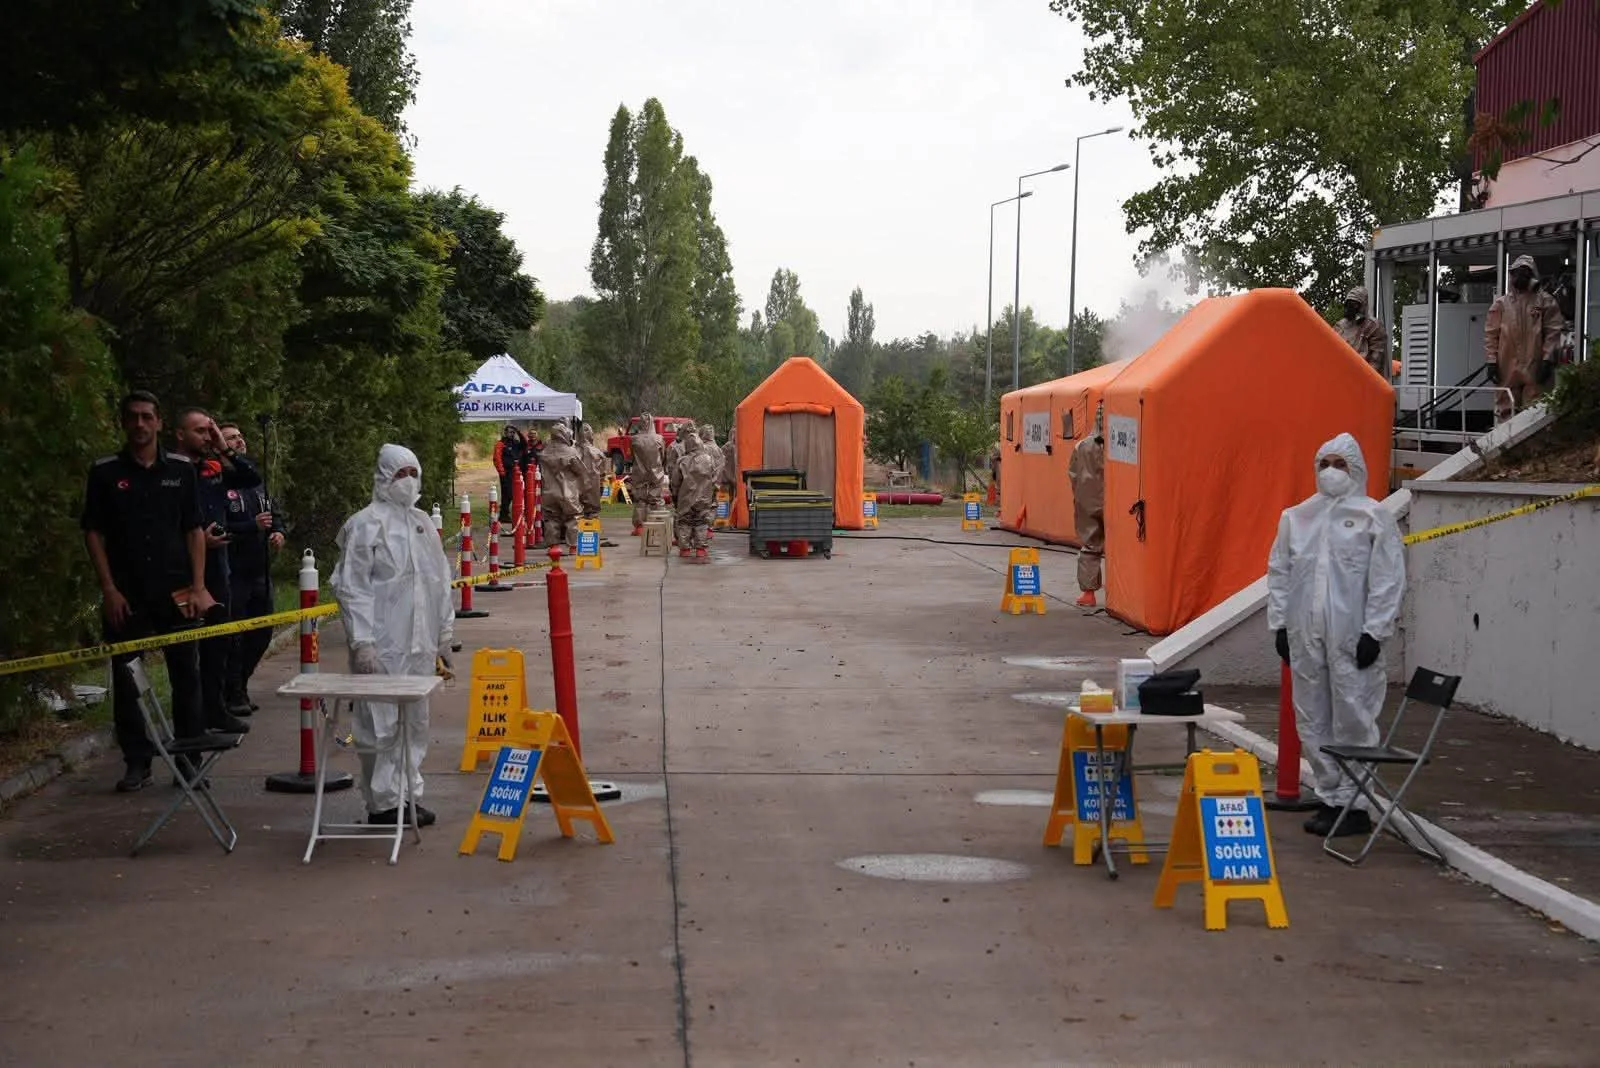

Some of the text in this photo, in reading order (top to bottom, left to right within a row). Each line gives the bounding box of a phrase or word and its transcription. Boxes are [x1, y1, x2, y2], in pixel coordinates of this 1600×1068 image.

[463, 382, 526, 395] AFAD
[458, 402, 545, 412] FAD KIRIKKALE
[483, 712, 507, 722] ILIK
[510, 752, 529, 762] AFAD
[490, 784, 522, 801] SOĞUK
[488, 802, 513, 817] ALAN
[1219, 803, 1244, 812] AFAD
[1215, 842, 1262, 860] SOĞUK
[1223, 865, 1258, 879] ALAN
